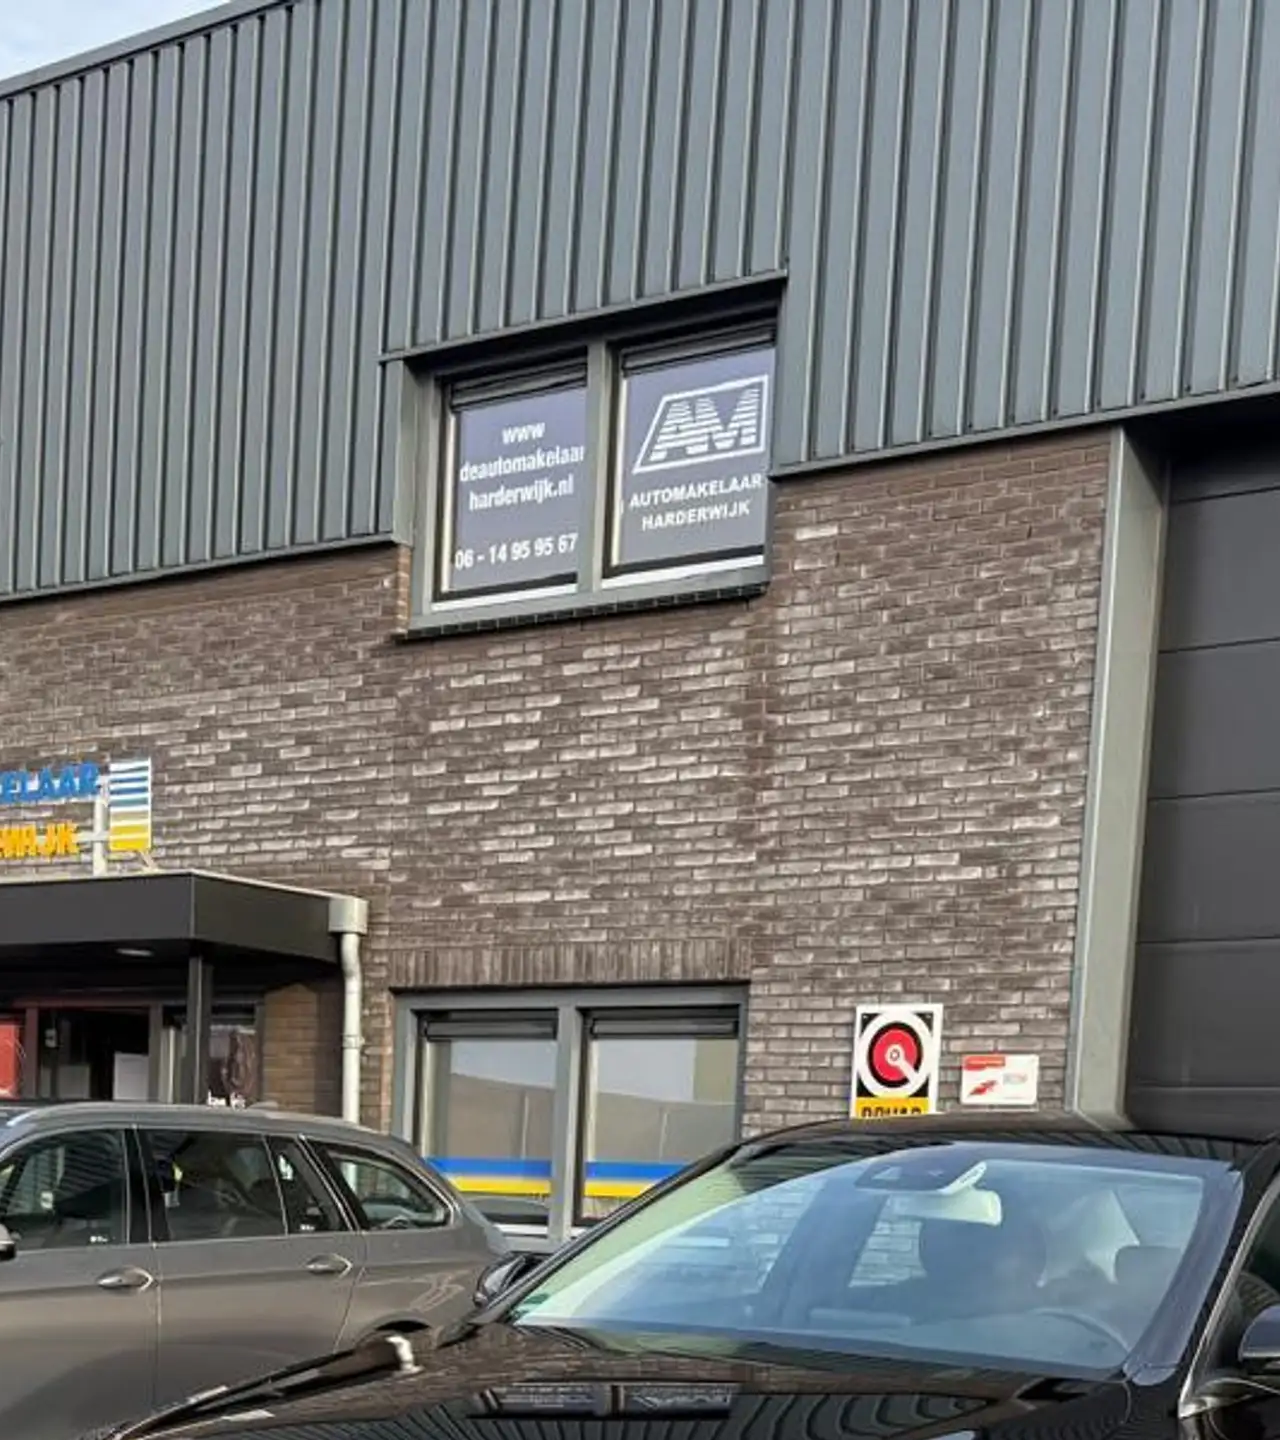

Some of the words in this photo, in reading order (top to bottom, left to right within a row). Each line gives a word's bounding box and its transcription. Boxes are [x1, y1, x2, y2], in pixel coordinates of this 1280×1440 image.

[502, 422, 546, 444] www
[469, 472, 574, 511] harderwijk.nl
[629, 473, 763, 509] AUTOMAKELAAR
[641, 500, 750, 531] HARDERWIJK
[489, 543, 507, 565] 14
[558, 532, 578, 554] 67
